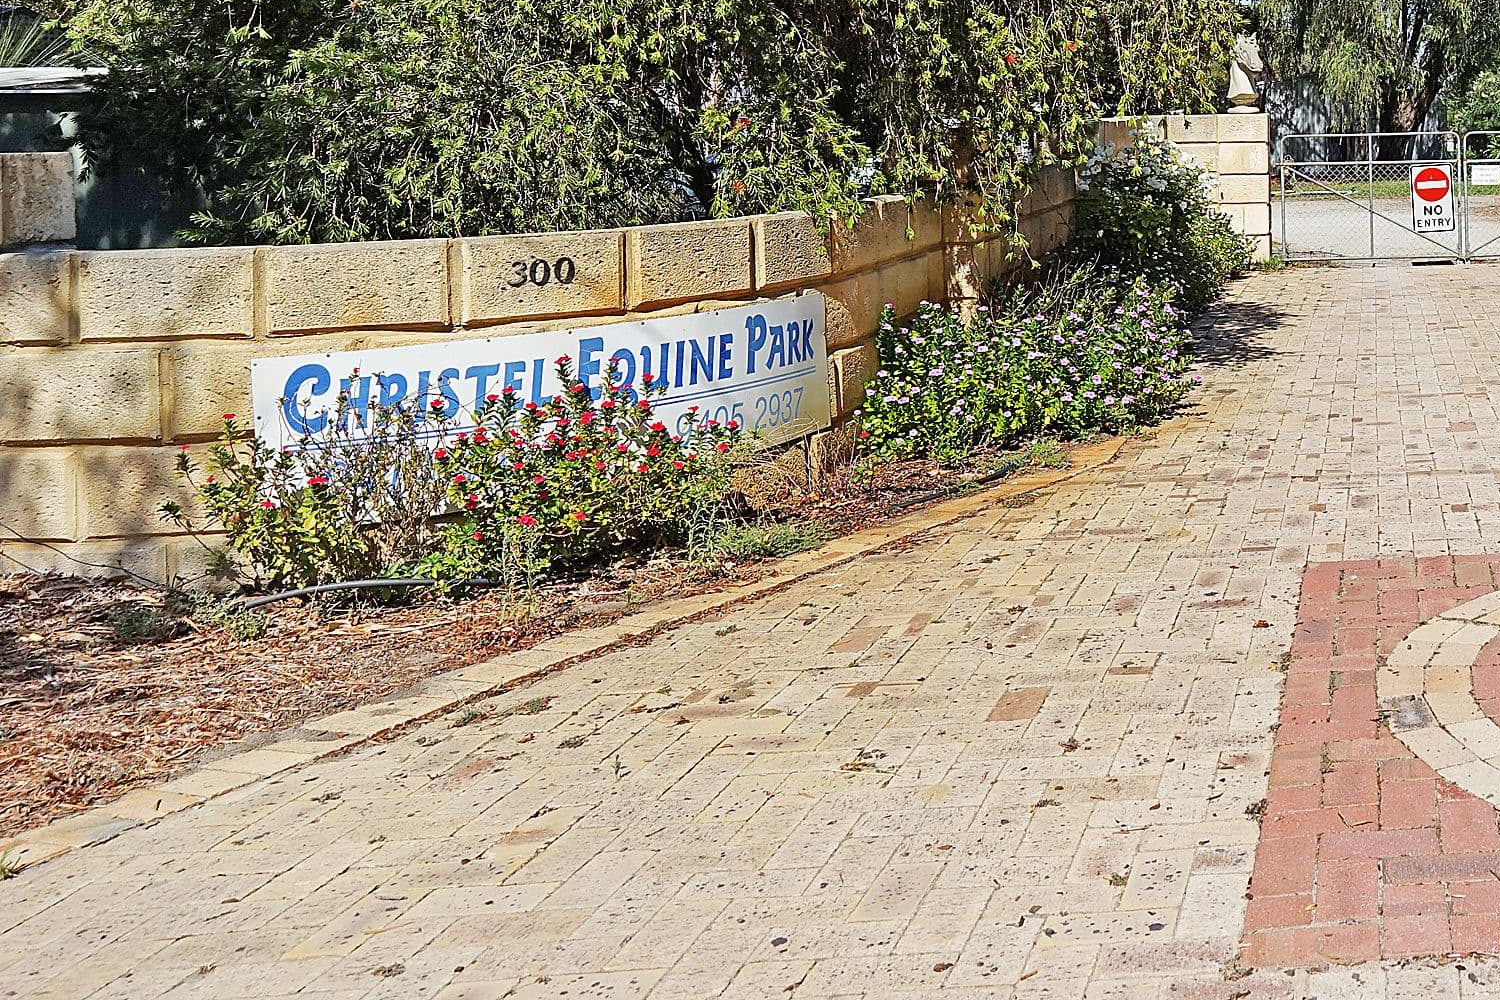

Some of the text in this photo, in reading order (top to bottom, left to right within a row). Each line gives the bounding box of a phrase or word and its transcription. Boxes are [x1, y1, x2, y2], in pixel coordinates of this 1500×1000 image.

[1417, 217, 1451, 228] ENTRY
[1423, 204, 1443, 216] NO
[507, 256, 576, 288] 300
[283, 314, 816, 435] CHRISTEL EQUINE PARK
[755, 386, 804, 430] 2937
